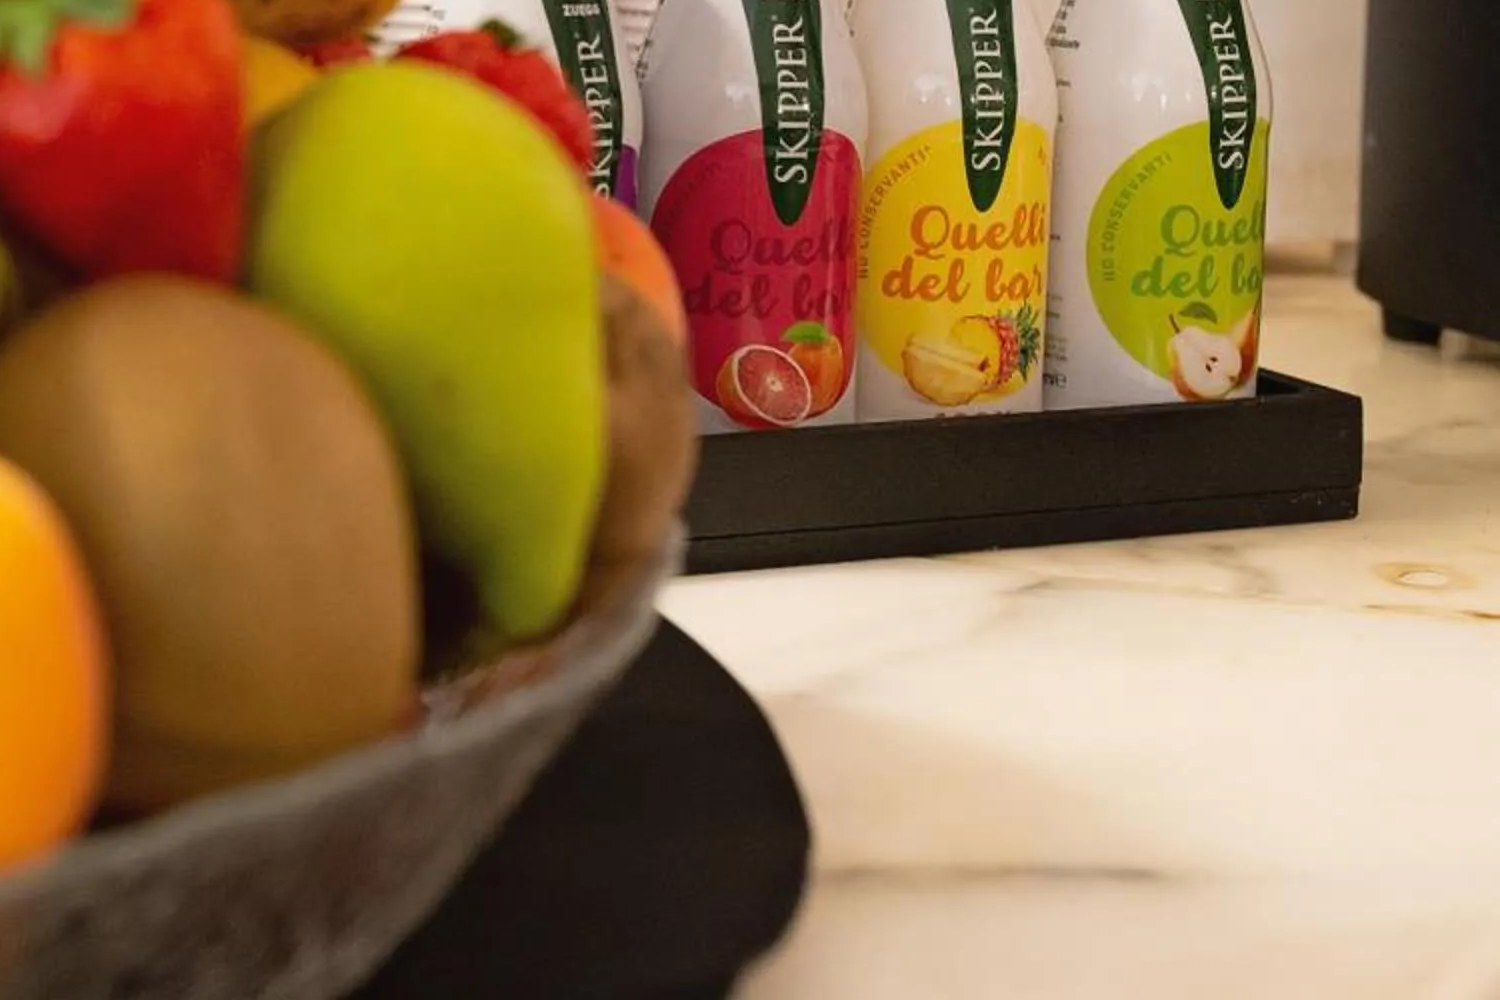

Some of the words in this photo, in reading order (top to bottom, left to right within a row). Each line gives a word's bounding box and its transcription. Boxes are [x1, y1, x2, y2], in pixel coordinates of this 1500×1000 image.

[772, 14, 811, 183] SKIPPER
[970, 7, 1006, 171] SKIPPER
[1209, 13, 1248, 170] SKIPPER
[910, 202, 1046, 260] Quelli
[683, 272, 779, 318] del
[882, 255, 971, 303] del
[985, 257, 1042, 303] bar
[1130, 255, 1219, 299] del
